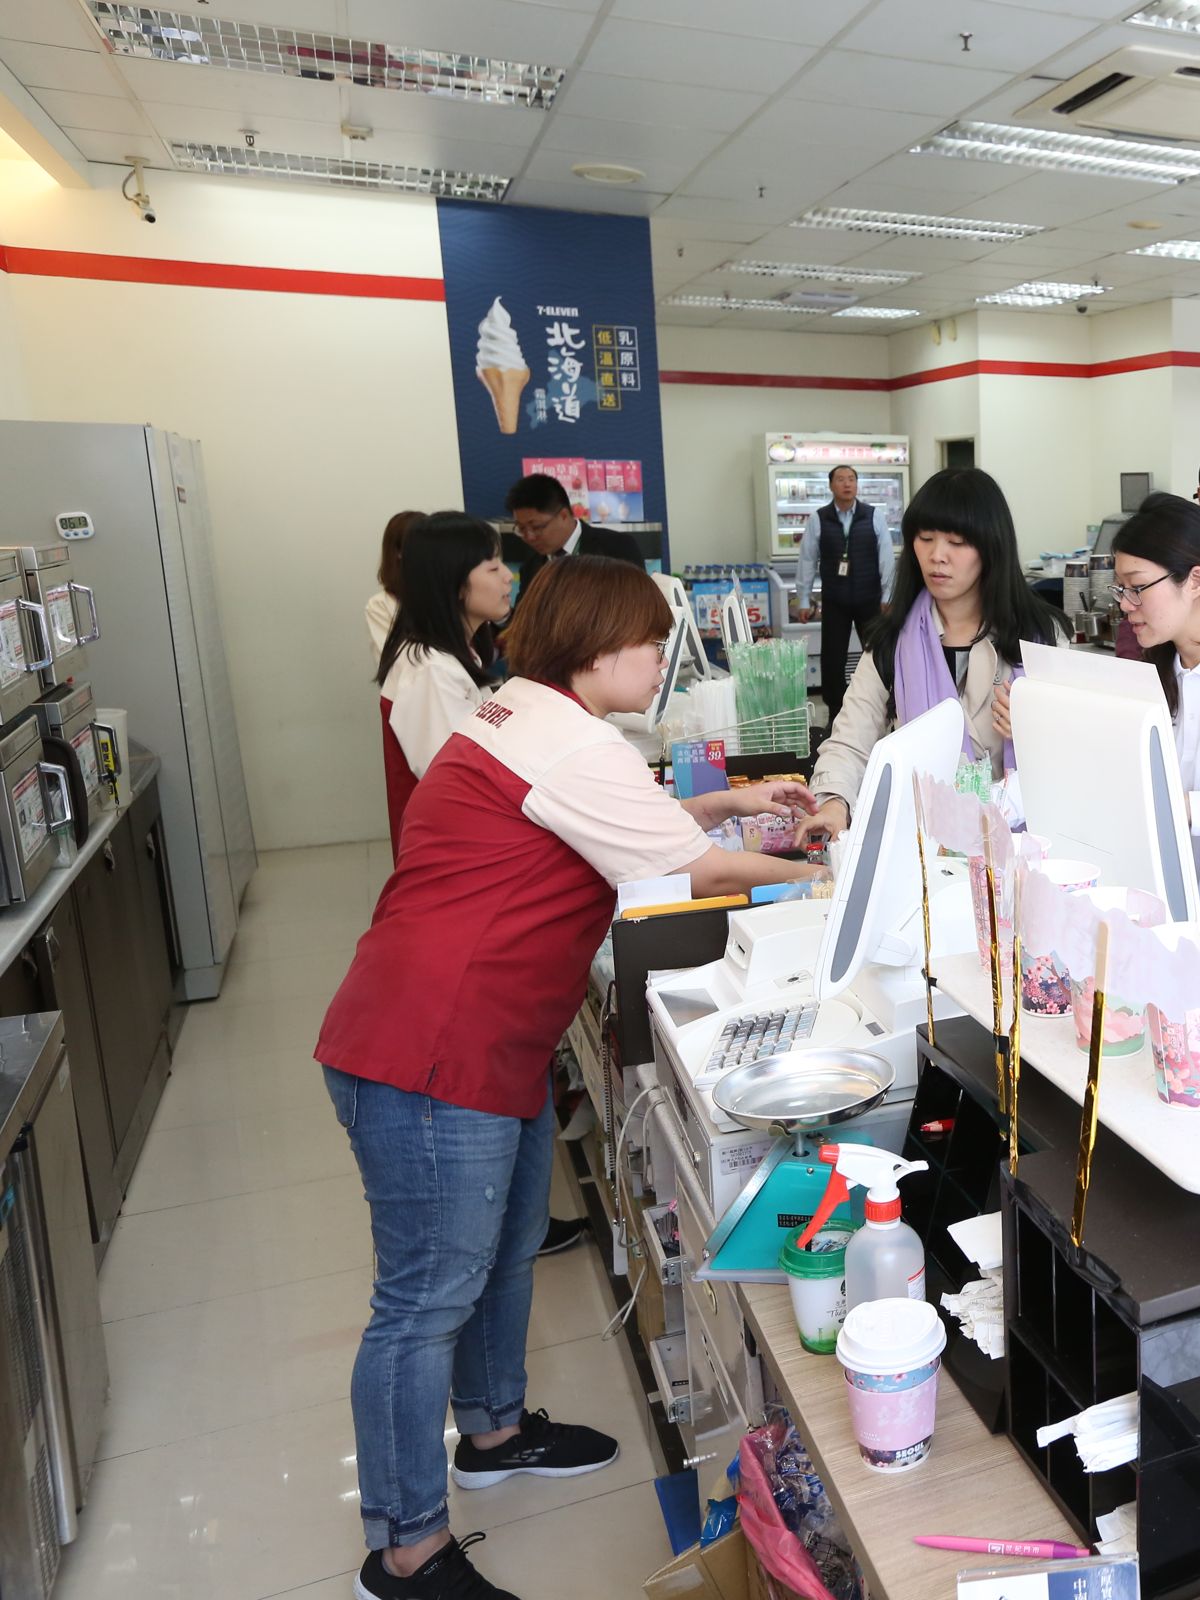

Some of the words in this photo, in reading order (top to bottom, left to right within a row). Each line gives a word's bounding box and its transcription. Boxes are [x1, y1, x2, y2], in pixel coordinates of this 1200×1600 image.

[546, 322, 585, 423] 北海道
[598, 331, 616, 408] 低溫直送
[618, 331, 635, 387] 乳原料
